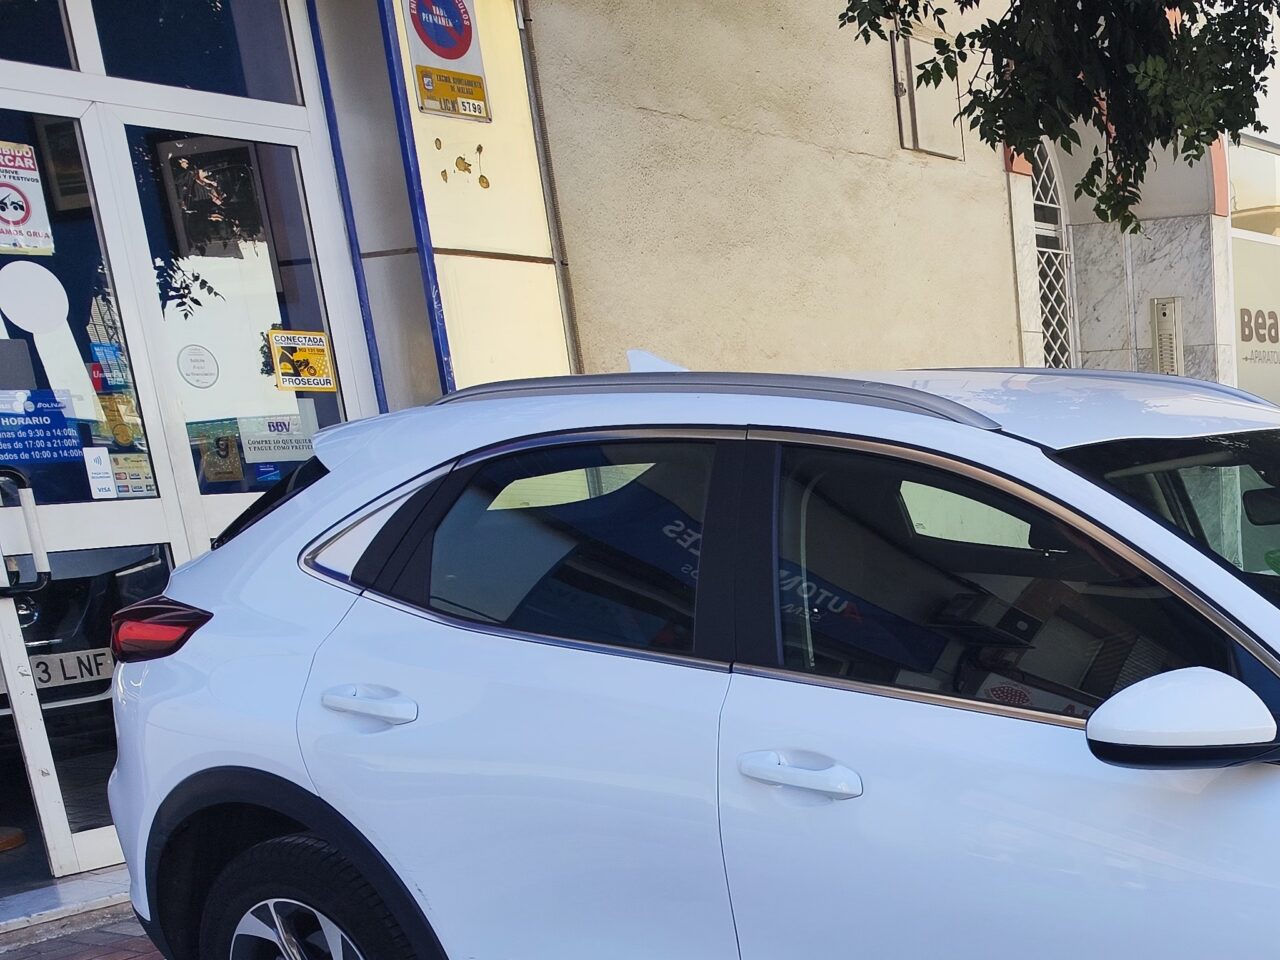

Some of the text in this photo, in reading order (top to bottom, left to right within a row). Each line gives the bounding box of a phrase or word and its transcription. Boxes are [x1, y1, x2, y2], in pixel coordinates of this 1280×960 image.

[274, 335, 325, 344] CONECTADA
[282, 377, 332, 386] PROSEGUR
[1, 416, 51, 425] HORARIO
[17, 430, 27, 438] de
[28, 429, 44, 438] 9:30
[53, 428, 77, 436] 14:00h
[14, 440, 23, 448] de
[25, 440, 45, 448] 17:00
[53, 439, 78, 447] 21:00h
[31, 450, 51, 458] 10:00
[35, 652, 107, 684] 3 LNF
